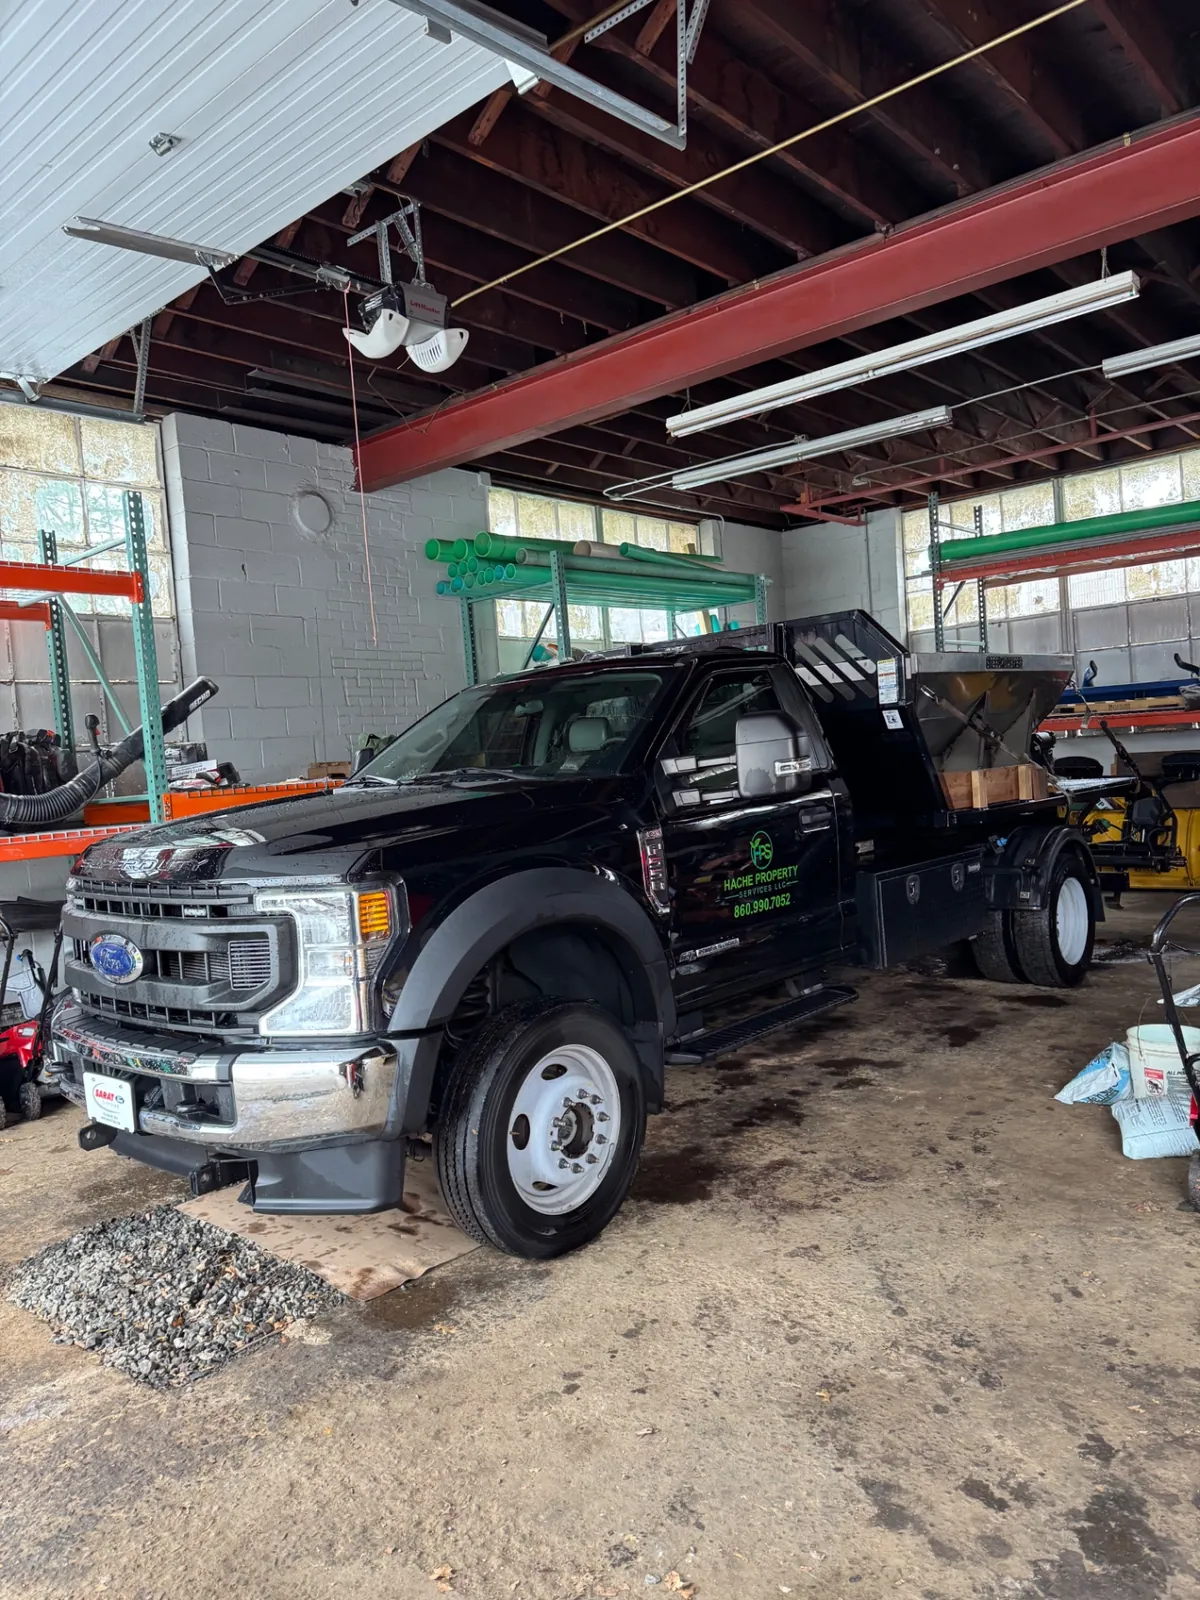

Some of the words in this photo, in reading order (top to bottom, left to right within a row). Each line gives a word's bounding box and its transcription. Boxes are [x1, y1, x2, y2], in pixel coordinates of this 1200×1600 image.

[139, 858, 209, 872] DUTY
[723, 874, 754, 892] HACHE
[755, 864, 799, 885] PROPERTY
[739, 884, 772, 899] SERVICES
[774, 881, 786, 890] LLC
[733, 892, 791, 918] 860.990.7052
[100, 948, 124, 970] Ford
[95, 1089, 115, 1102] SARAT
